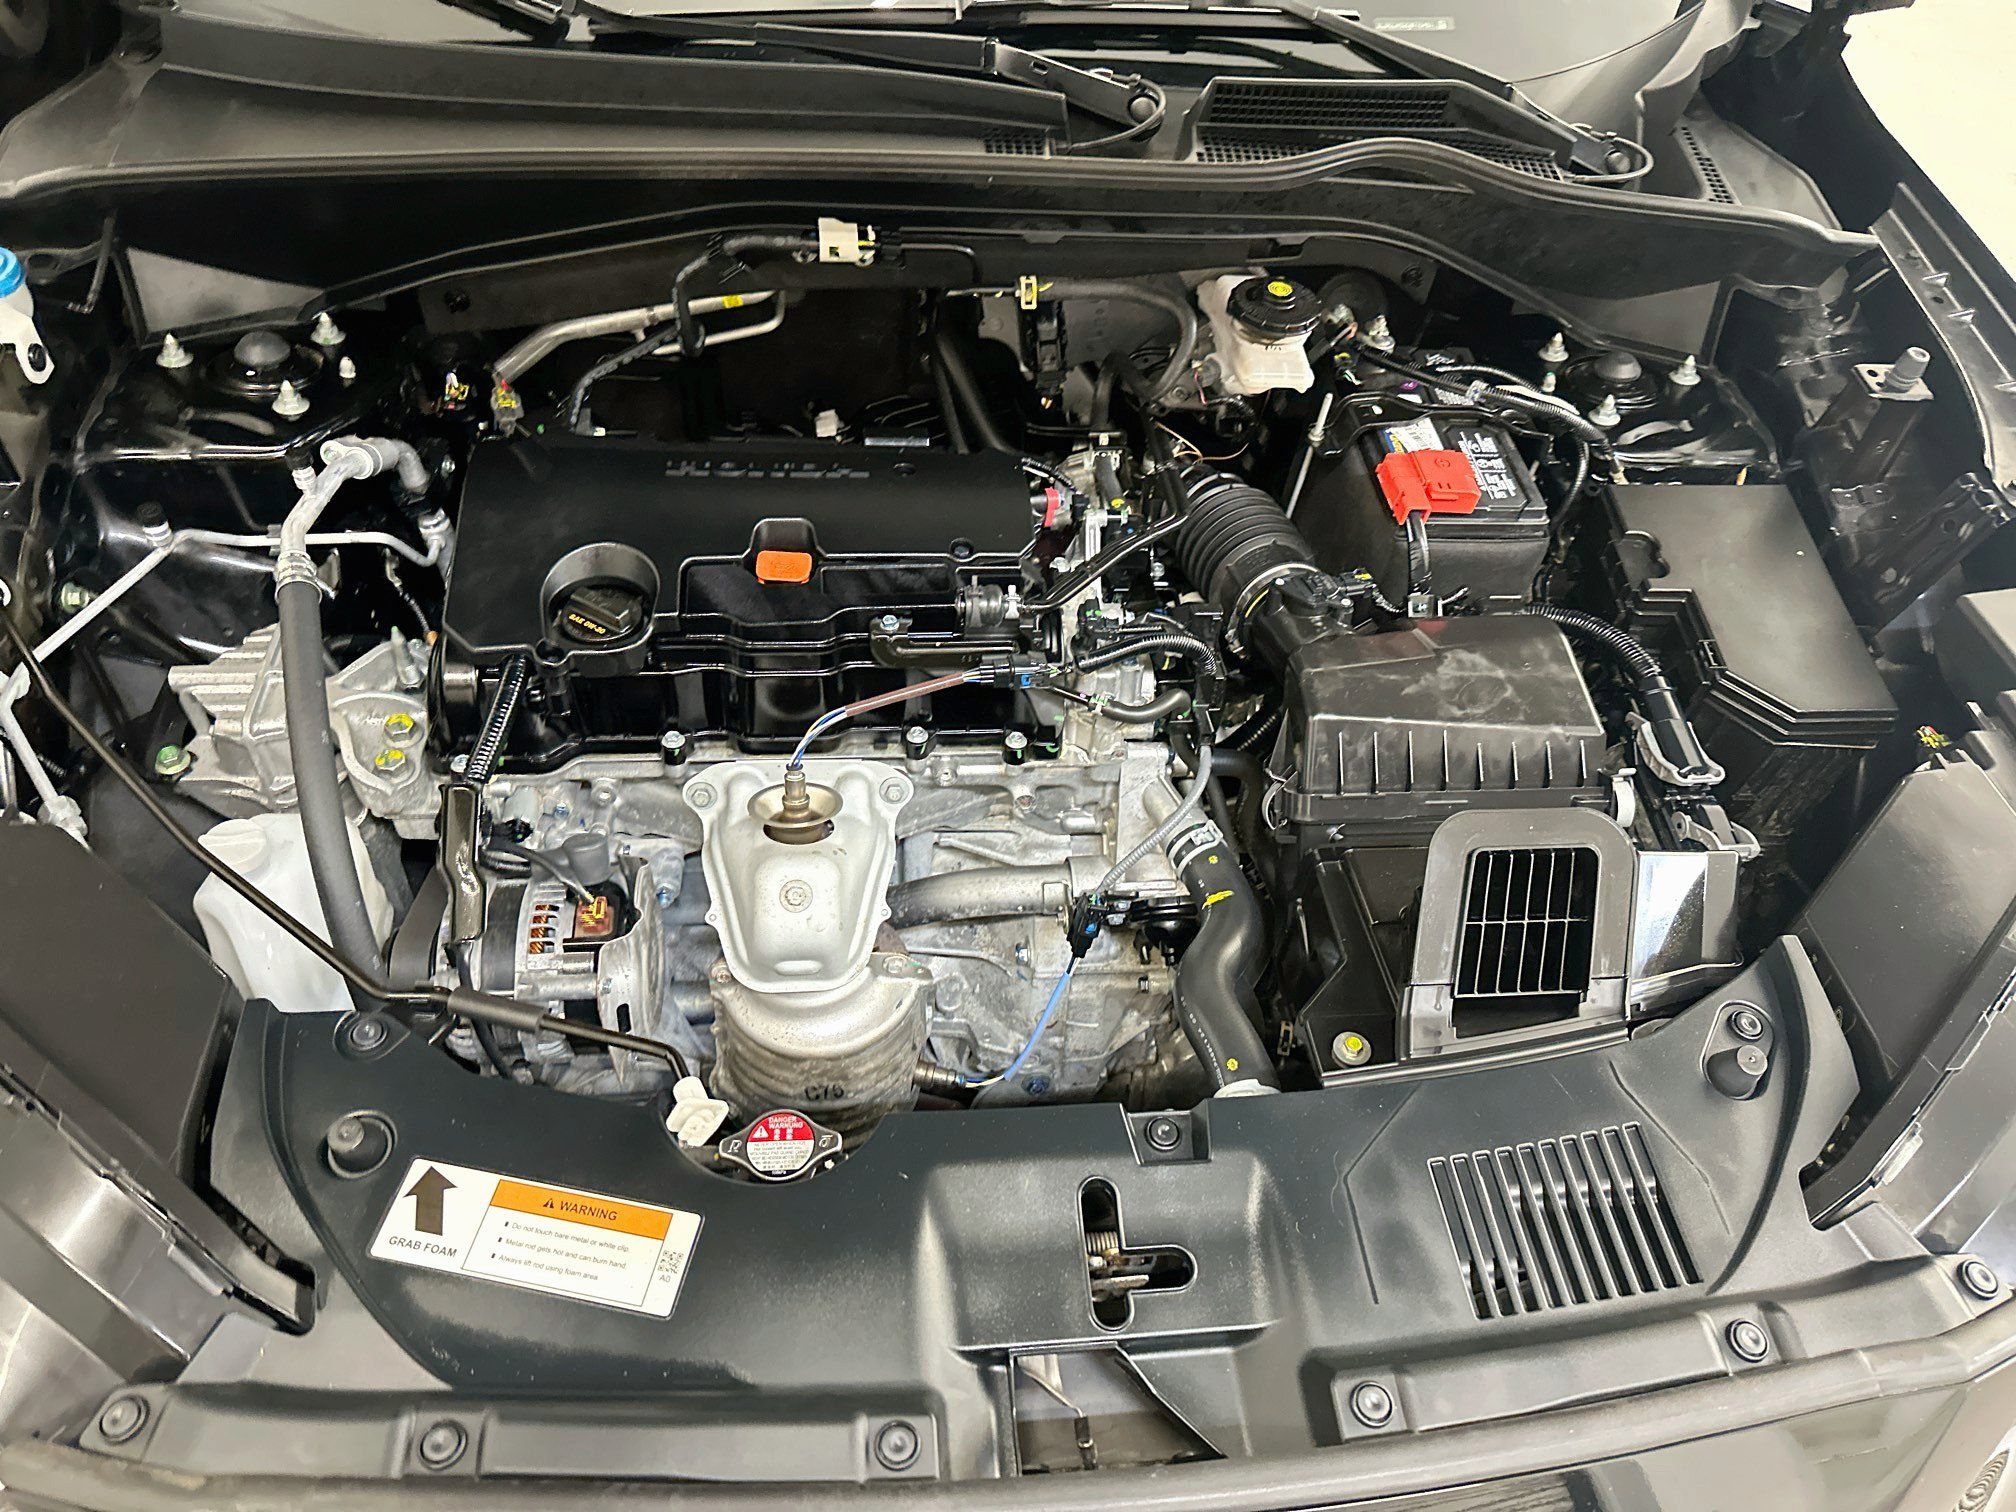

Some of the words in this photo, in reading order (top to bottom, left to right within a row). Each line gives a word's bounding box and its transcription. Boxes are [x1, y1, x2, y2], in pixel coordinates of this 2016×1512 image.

[560, 1201, 618, 1221] WARNING
[389, 1236, 422, 1250] GRAB
[423, 1243, 457, 1258] FOAM
[511, 1222, 522, 1230] Do
[523, 1225, 534, 1233] not
[534, 1227, 553, 1236] touch
[554, 1231, 569, 1240] bare
[570, 1235, 589, 1244] metal
[598, 1241, 615, 1250] white
[505, 1238, 524, 1247] Metal
[524, 1242, 536, 1250] rod
[536, 1245, 551, 1254] gets
[552, 1248, 564, 1256] hot
[564, 1251, 578, 1259] and
[592, 1256, 608, 1265] burn
[498, 1254, 521, 1265] Always
[533, 1261, 544, 1269] rod
[545, 1264, 564, 1274] using
[564, 1268, 581, 1277] foam
